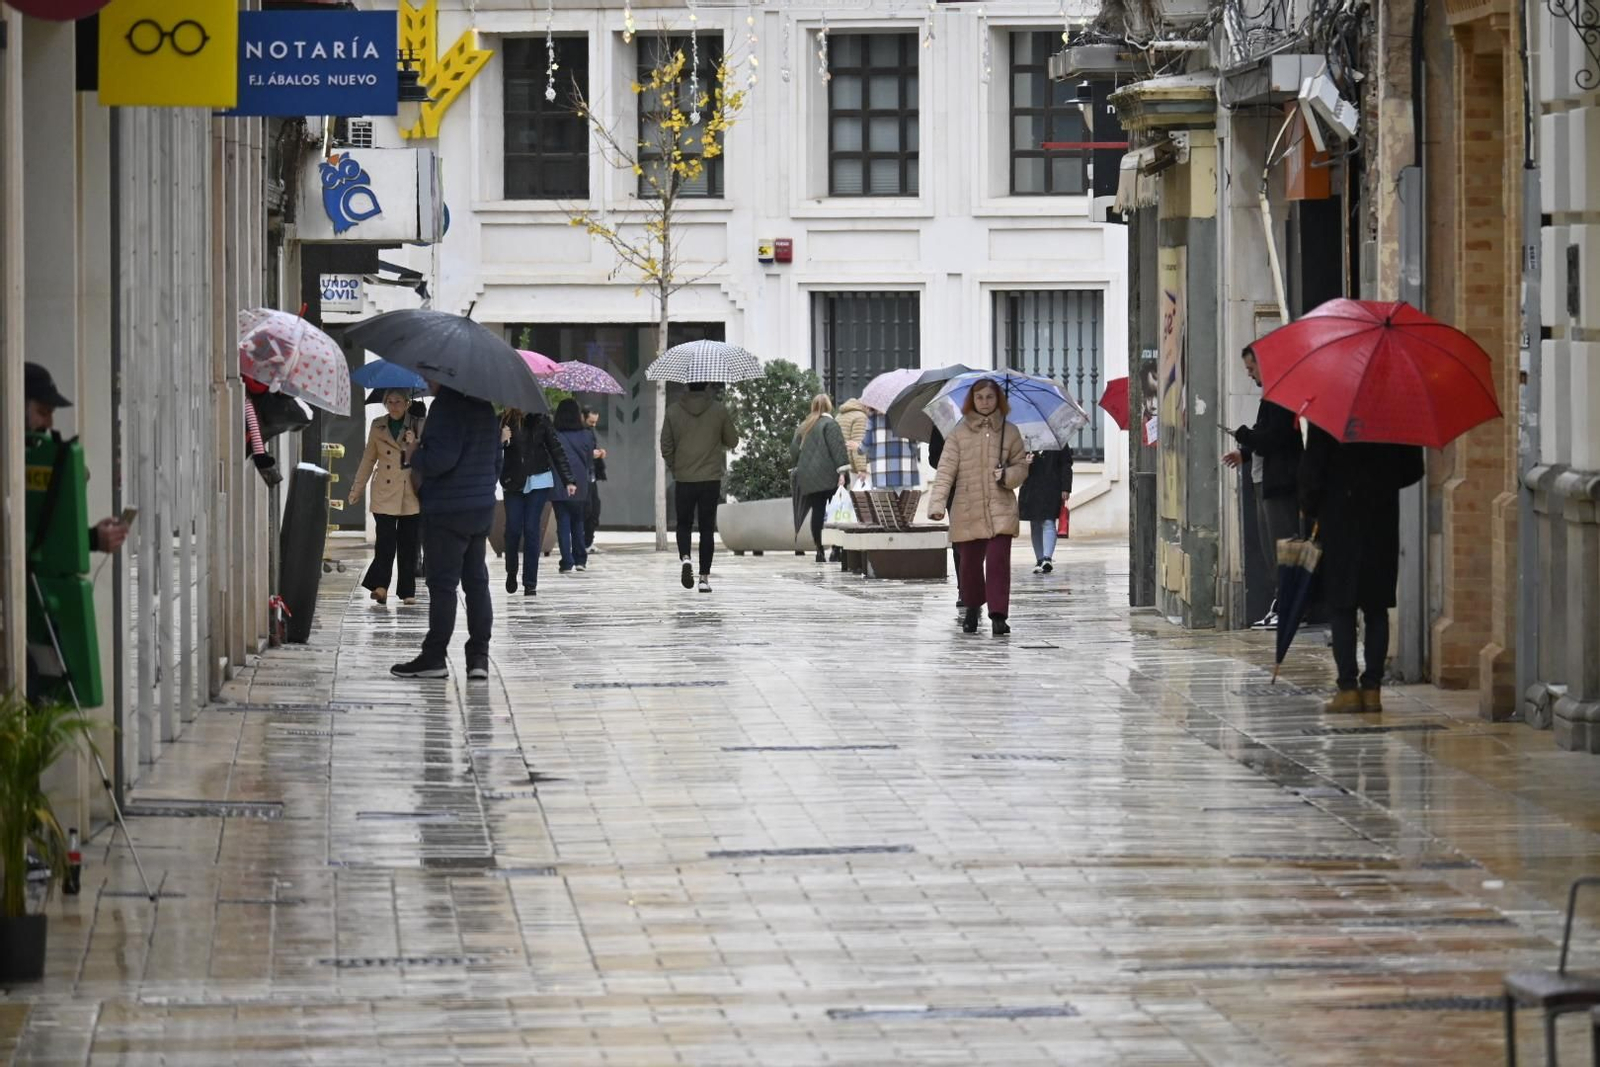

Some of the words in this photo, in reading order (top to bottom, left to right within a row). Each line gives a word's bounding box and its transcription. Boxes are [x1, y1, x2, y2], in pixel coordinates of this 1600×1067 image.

[246, 36, 380, 59] NOTARÍA
[268, 71, 320, 86] ÁBALOS
[328, 74, 377, 86] NUEVO
[321, 279, 358, 289] UNDO
[320, 289, 358, 300] OVIL
